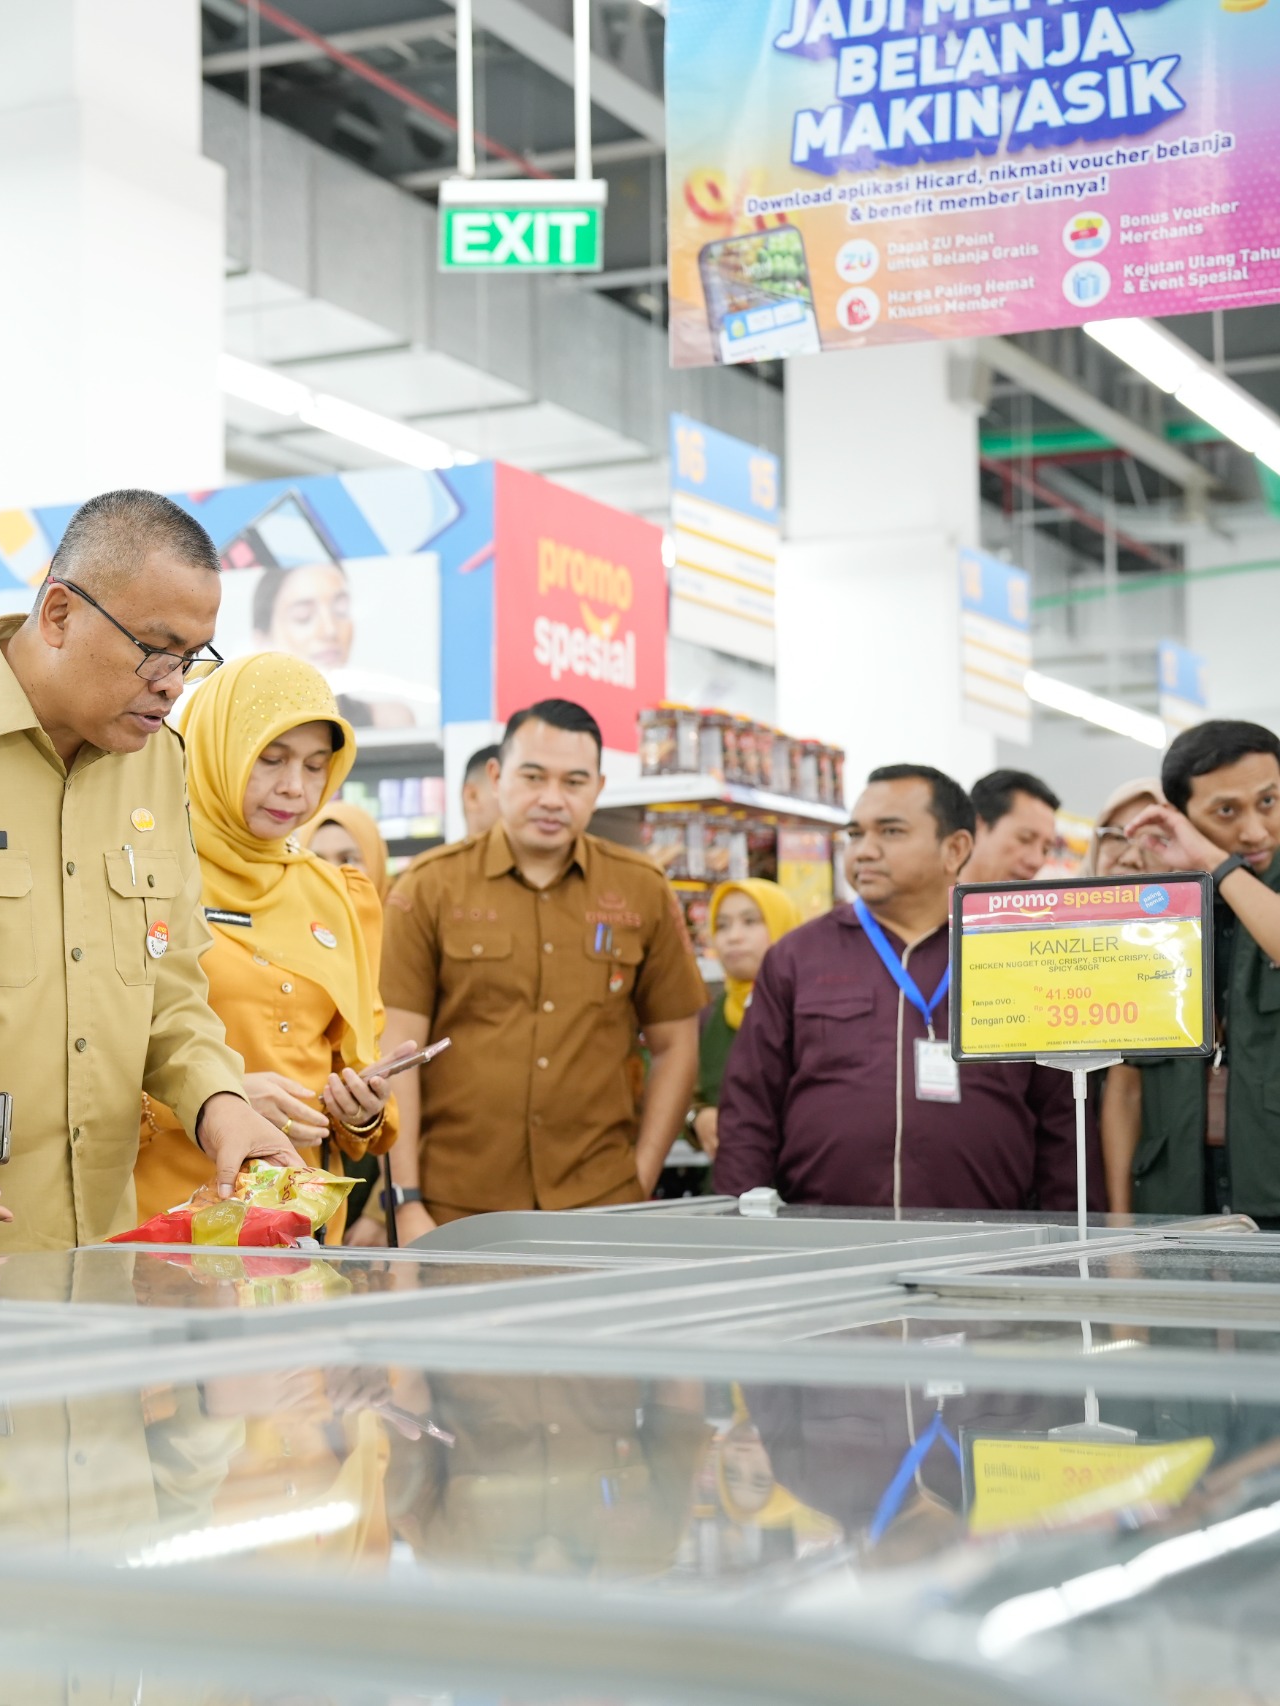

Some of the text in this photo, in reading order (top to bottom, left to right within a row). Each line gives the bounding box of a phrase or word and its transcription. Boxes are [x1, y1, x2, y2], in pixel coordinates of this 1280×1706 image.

[775, 0, 905, 49] JADI
[837, 8, 1132, 97] BELANJA
[793, 57, 1184, 162] MAKIN ASIK
[747, 134, 1232, 214] Download aplikasi Hicard, nikmati voucher belanja
[850, 176, 1107, 222] & benefit member lainnya!
[1120, 201, 1240, 229] Bonus Voucher
[451, 211, 590, 264] EXIT
[887, 232, 994, 257] Dapat ZU Point
[1120, 222, 1204, 245] Merchants
[887, 243, 1039, 272] untuk Belanja Gratis
[1123, 260, 1185, 281] Kejutan
[1188, 252, 1236, 272] Ulang
[888, 277, 1035, 307] Harga Paling Hemat
[1123, 266, 1249, 295] & Event Spesial
[887, 296, 1007, 319] Khusus Member
[537, 537, 633, 611] promo
[532, 615, 636, 690] spesial
[988, 885, 1140, 912] promo spesial
[1029, 936, 1120, 956] KANZLER
[969, 962, 1004, 970] CHICKEN
[1005, 960, 1039, 968] NUGGET
[1040, 959, 1056, 967] ORI,
[1092, 955, 1117, 964] STICK
[1118, 953, 1151, 963] CRISPY,
[1048, 964, 1100, 973] SPICY 450GR
[1137, 972, 1150, 982] Rp
[971, 999, 994, 1008] Tanpa
[995, 998, 1012, 1006] OVO
[1045, 986, 1092, 1000] 41.900
[970, 1015, 1005, 1027] Dengan
[1006, 1014, 1026, 1024] OVO
[1047, 1001, 1139, 1029] 39.900
